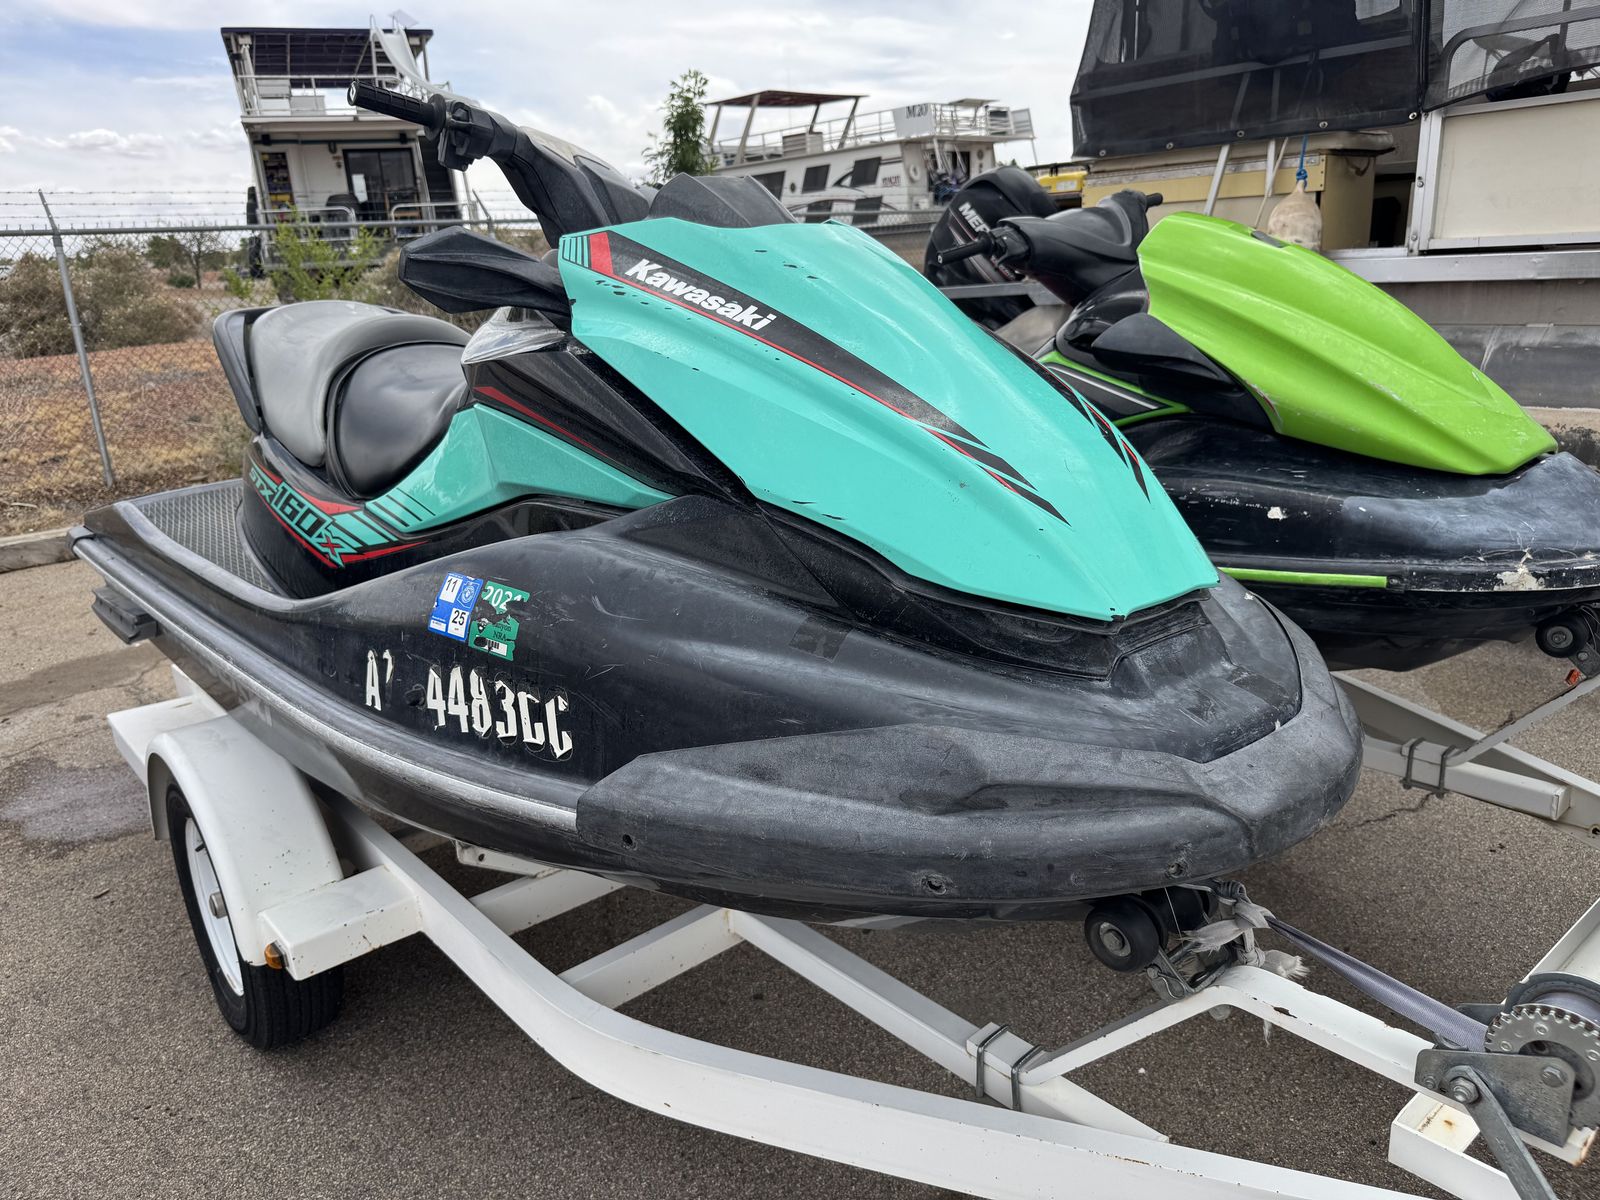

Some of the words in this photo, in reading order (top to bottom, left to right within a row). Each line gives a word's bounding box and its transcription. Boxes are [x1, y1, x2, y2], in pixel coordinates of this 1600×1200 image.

[624, 258, 777, 331] Kawasaki
[446, 578, 459, 593] 11
[451, 609, 466, 626] 25
